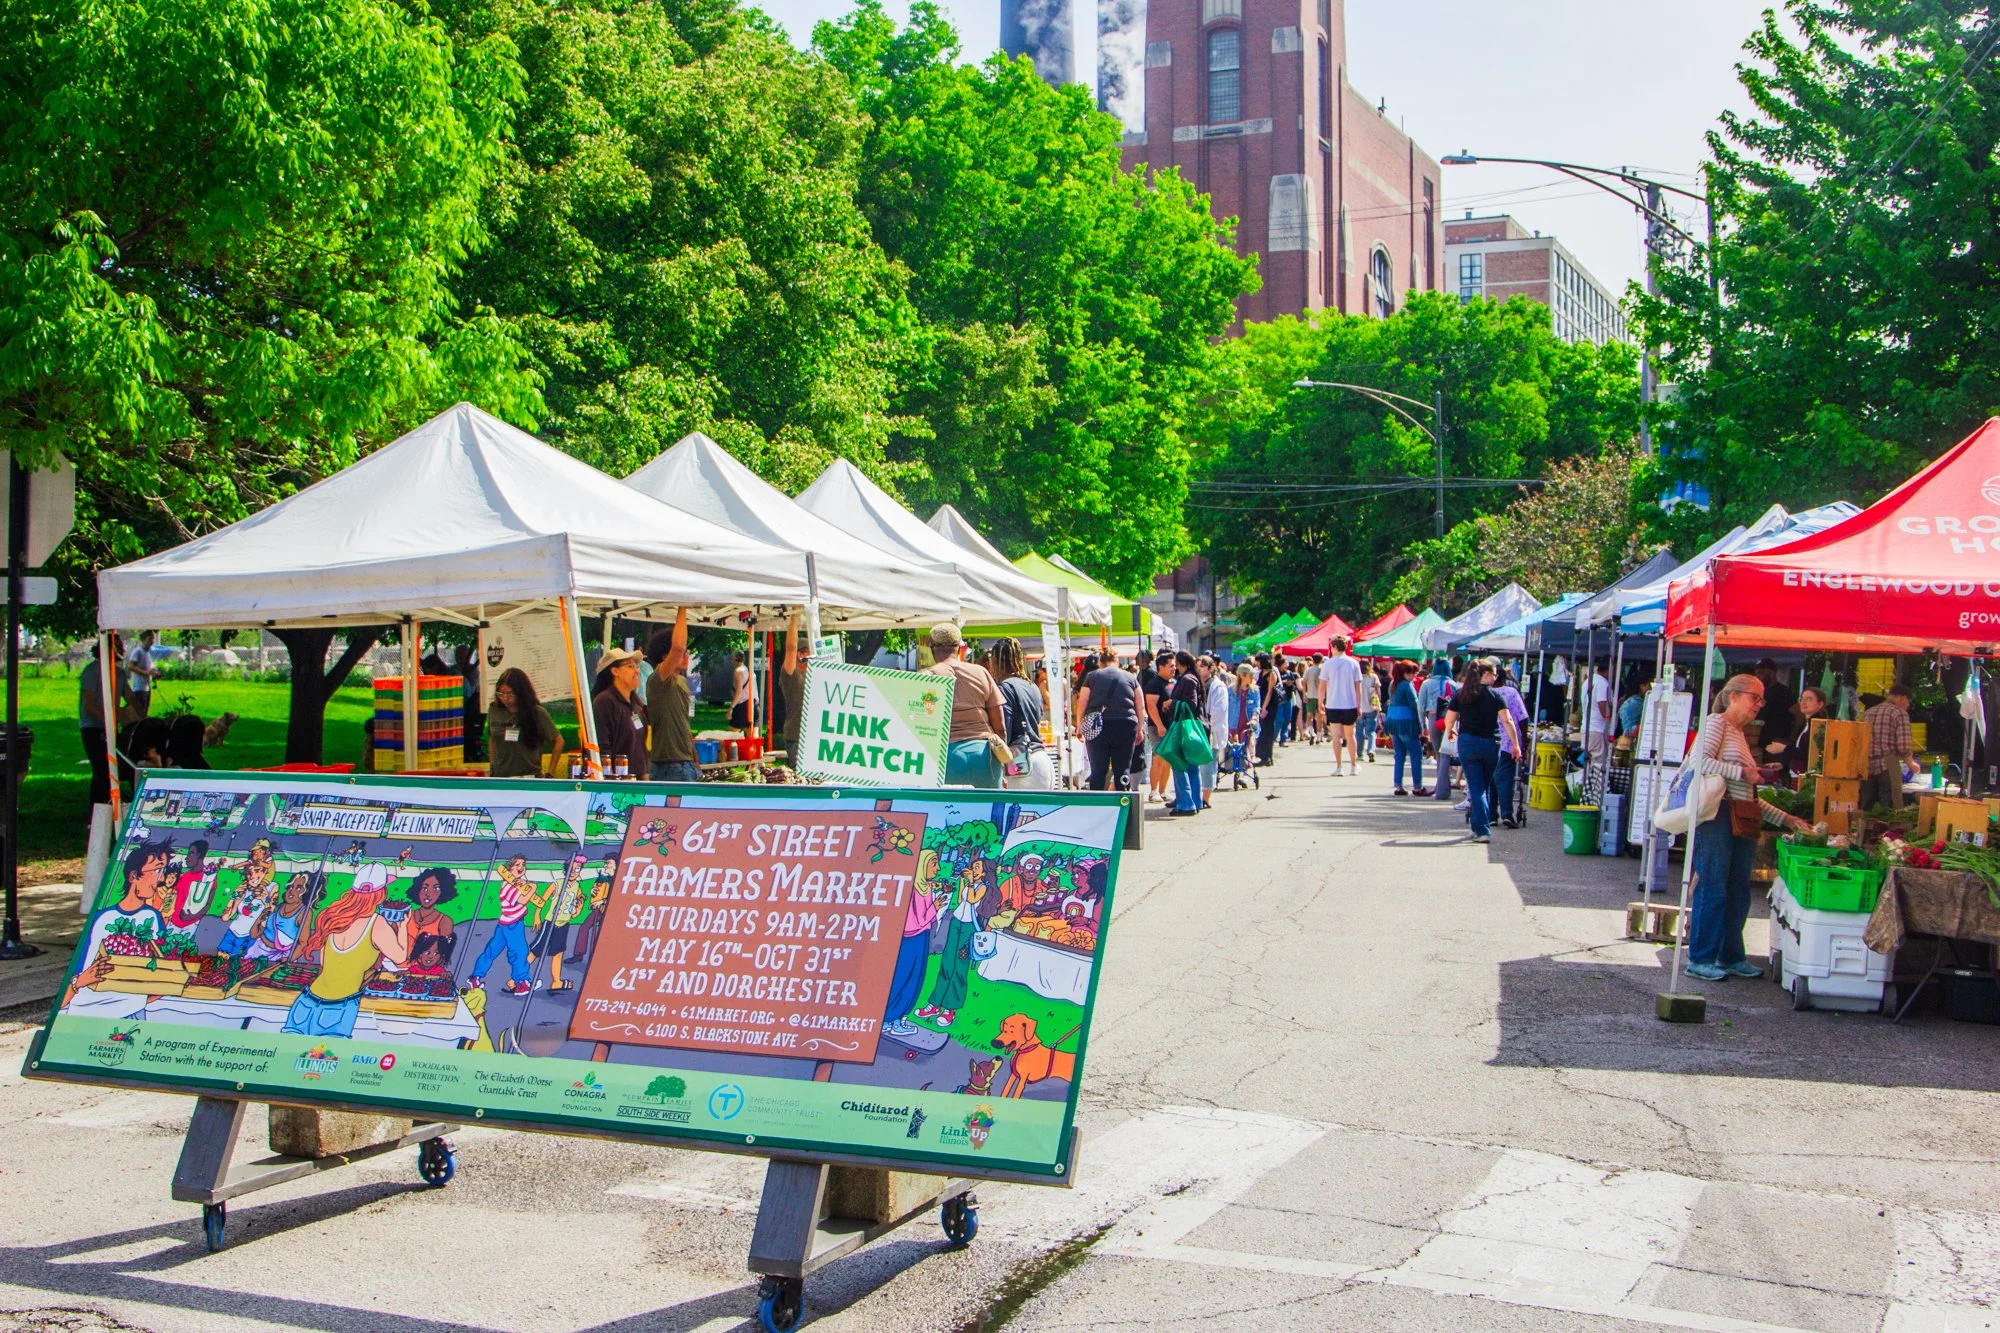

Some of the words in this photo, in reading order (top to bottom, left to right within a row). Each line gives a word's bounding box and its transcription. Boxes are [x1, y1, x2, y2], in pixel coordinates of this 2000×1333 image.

[1783, 569, 1975, 597] ENGLEWOOD
[825, 681, 867, 709] WE
[820, 710, 891, 741] LINK
[817, 739, 924, 775] MATCH
[300, 809, 332, 828] SNAP
[332, 812, 384, 833] ACCEPTED
[391, 815, 408, 832] WE
[408, 816, 434, 834] LINK
[435, 817, 478, 837] MATCH!
[682, 820, 742, 854] 61ST
[747, 823, 862, 858] STREET
[620, 856, 763, 901] FARMERS
[768, 862, 912, 907] MARKET
[625, 904, 759, 935] SATURDAYS
[765, 910, 880, 941] 9AM-2PM
[635, 937, 696, 964] MAY
[805, 946, 852, 974] 31ST
[611, 967, 656, 991] 61ST
[656, 970, 709, 996] AND
[711, 974, 859, 1006] DORCHESTER
[584, 998, 667, 1018] 773-241-6044
[680, 1005, 776, 1025] 61MARKET.ORG
[788, 1012, 876, 1033] @61MARKET
[645, 1022, 677, 1039] 6100
[680, 1026, 690, 1040] S.
[692, 1027, 771, 1047] BLACKSTONE
[771, 1033, 799, 1048] AVE
[143, 1036, 152, 1046] A
[154, 1039, 196, 1051] program
[198, 1040, 212, 1051] of
[211, 1041, 277, 1058] Experimental
[139, 1050, 172, 1064] Station
[174, 1055, 197, 1066] with
[197, 1056, 212, 1067] the
[214, 1060, 253, 1073] support
[255, 1061, 270, 1074] of:
[295, 1058, 338, 1073] ILLINOIS
[352, 1054, 378, 1065] BMO
[411, 1061, 459, 1072] WOODLAWN
[350, 1077, 382, 1087] Foundation
[403, 1071, 460, 1083] DISTRIBUTION
[474, 1070, 489, 1080] The
[490, 1072, 525, 1084] Elizabeth
[526, 1076, 553, 1087] Morse
[416, 1082, 442, 1092] TRUST
[478, 1085, 517, 1096] Charitable
[517, 1088, 538, 1098] Trust
[564, 1089, 607, 1100] CONAGRA
[562, 1103, 603, 1112] FOUNDATION
[617, 1107, 643, 1117] SOUTH
[644, 1109, 660, 1119] SIDE
[662, 1111, 692, 1121] WEEKLY
[840, 1100, 909, 1116] Chiditarod
[864, 1113, 908, 1124] Foundation
[939, 1135, 969, 1146] Illinois
[940, 1125, 969, 1138] Link
[971, 1127, 989, 1141] Up
